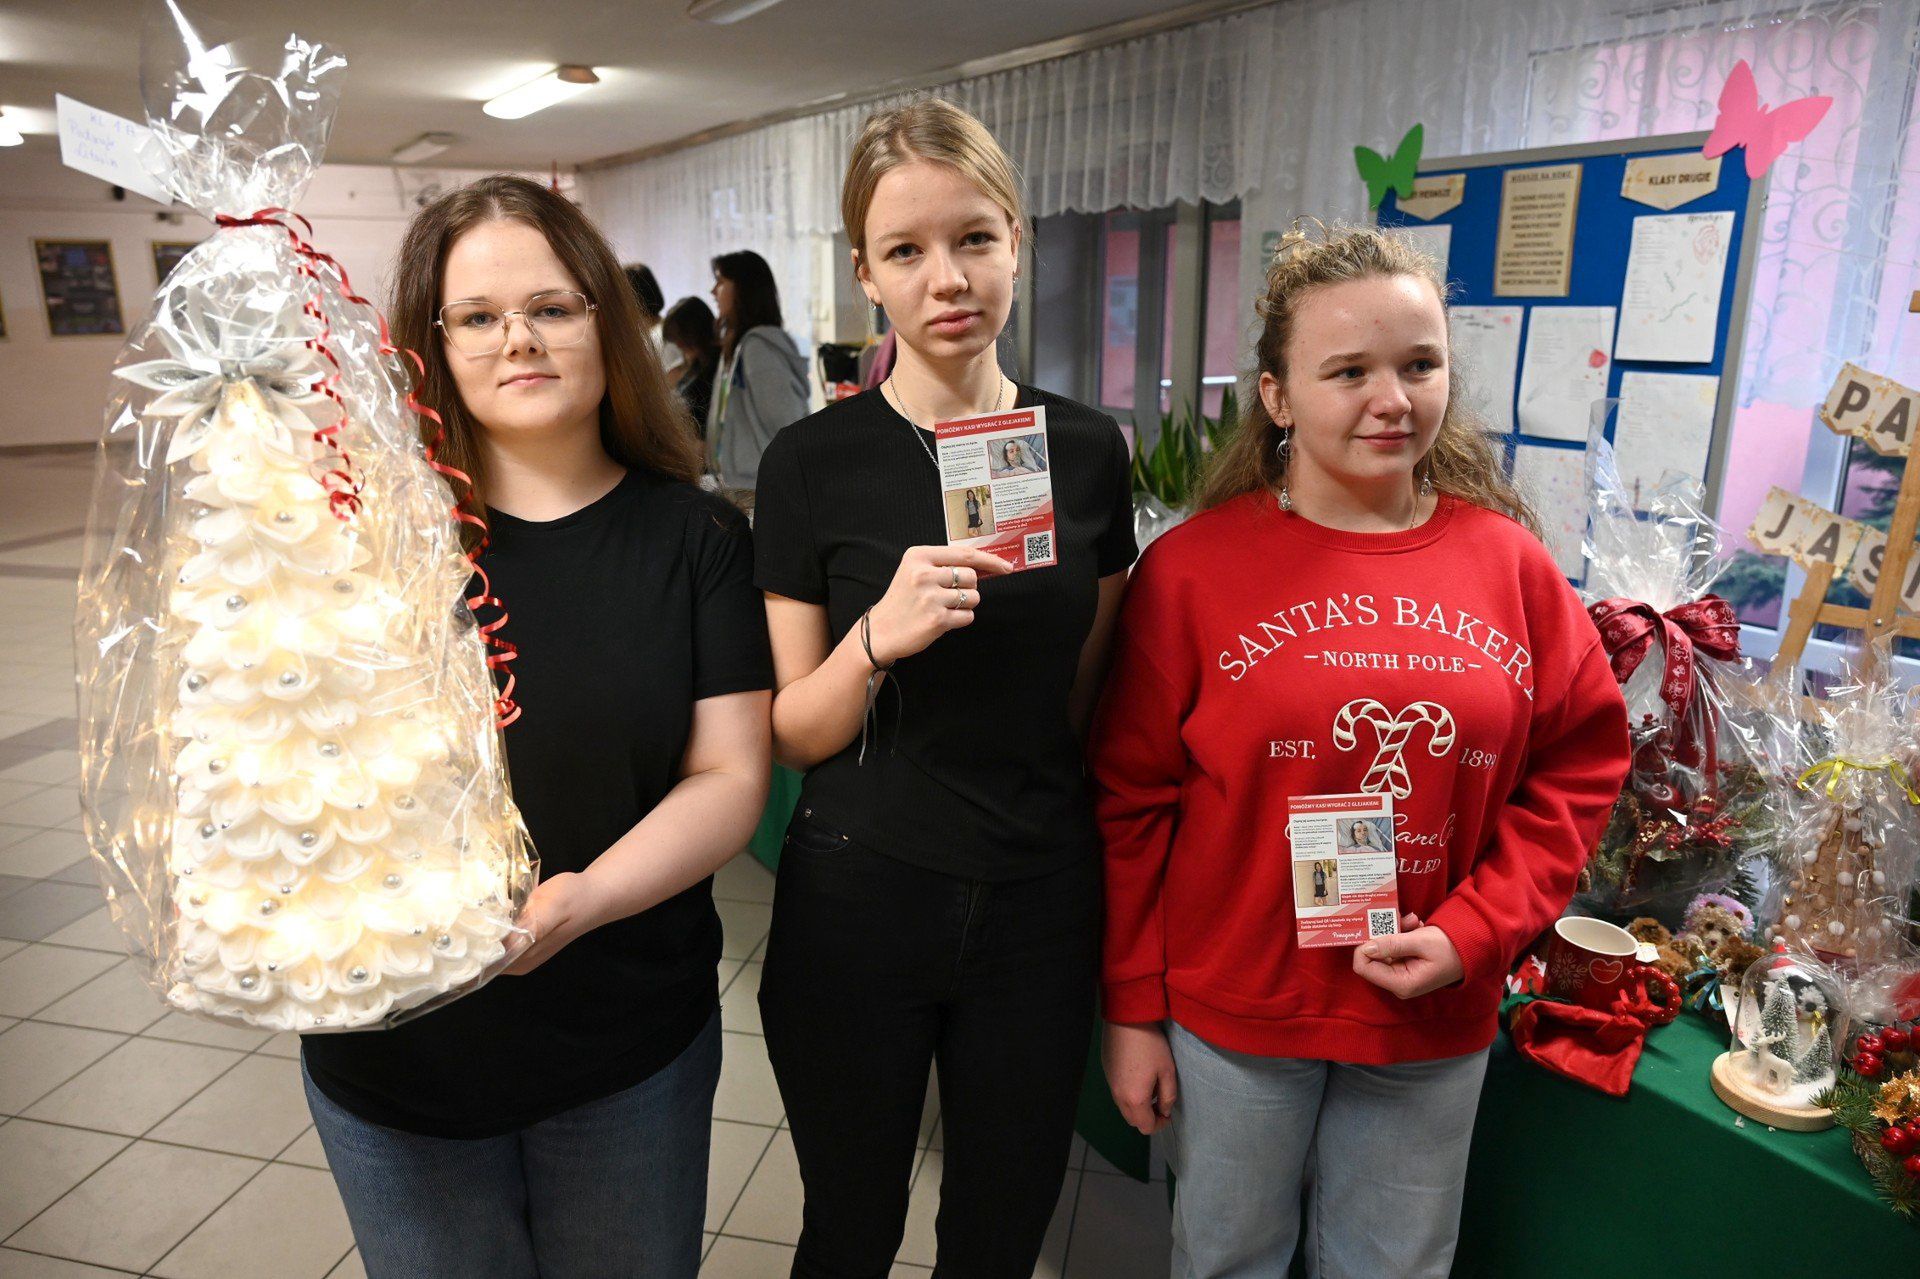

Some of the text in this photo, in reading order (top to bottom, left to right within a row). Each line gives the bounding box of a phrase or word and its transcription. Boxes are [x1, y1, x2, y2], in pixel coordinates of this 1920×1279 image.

[1648, 172, 1711, 186] KLASY DRUGIE
[1323, 651, 1465, 673] NORTH POLE
[1269, 740, 1316, 760] EST.
[1395, 857, 1441, 874] LLED
